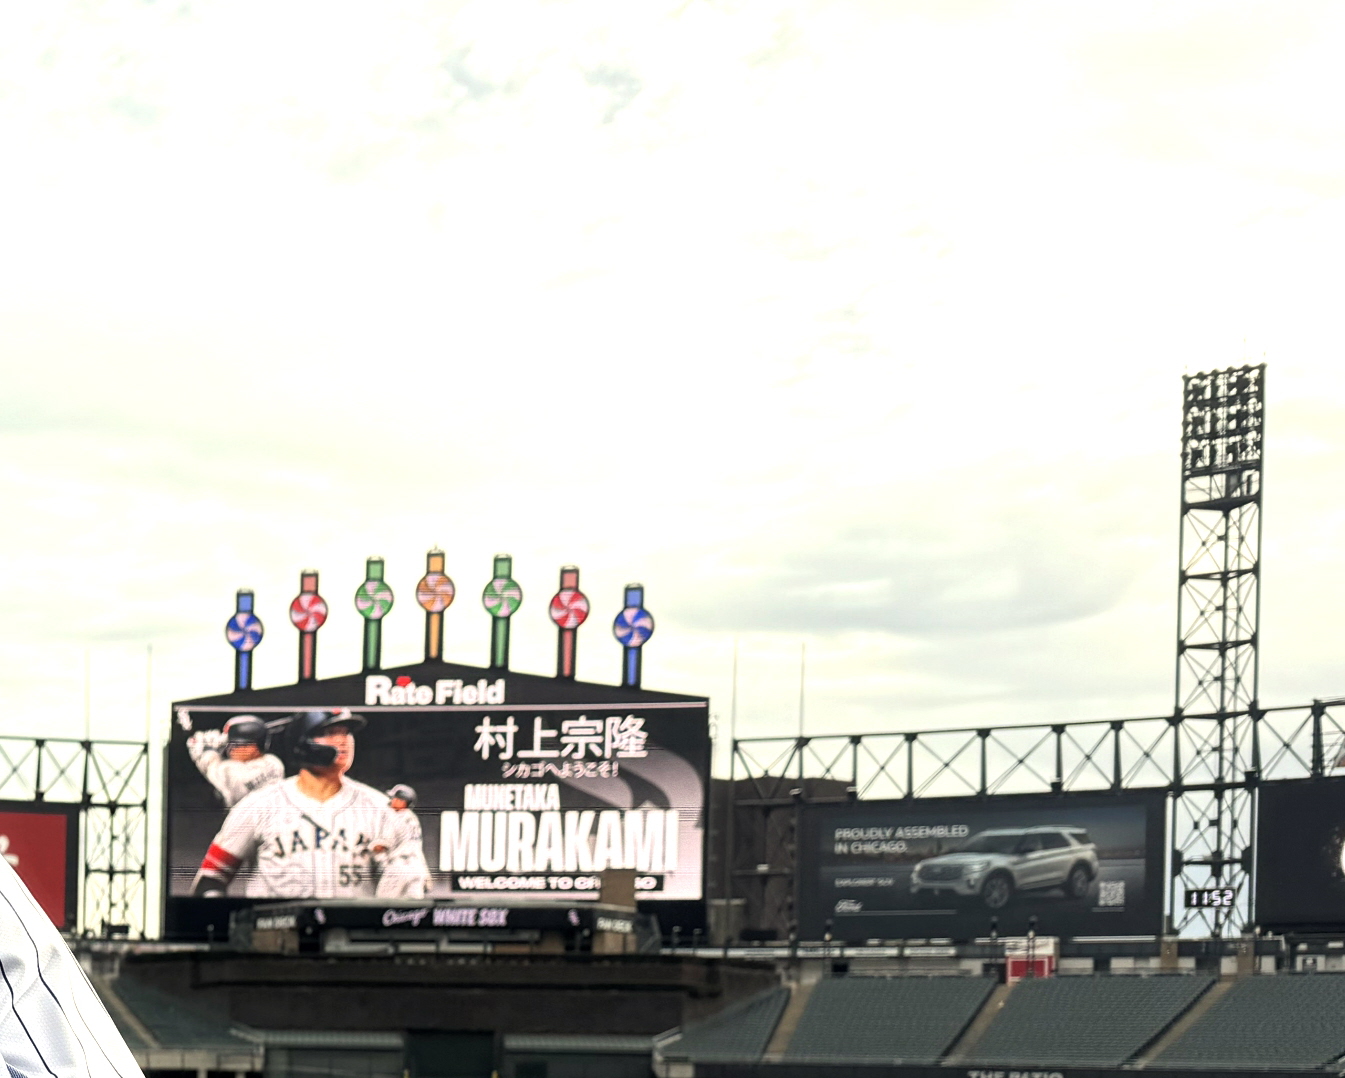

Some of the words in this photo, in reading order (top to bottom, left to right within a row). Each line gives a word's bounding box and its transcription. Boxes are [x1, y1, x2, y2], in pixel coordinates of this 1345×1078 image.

[365, 675, 433, 705] Rate
[435, 679, 505, 705] Field
[474, 714, 649, 760] 村上宗隆
[464, 783, 560, 811] MUNETAKA
[439, 810, 680, 872] MURAKAMI
[835, 827, 894, 840] PROUDLY
[895, 825, 969, 839] ASSEMBLED
[834, 842, 849, 854] IN
[339, 865, 361, 887] 55
[458, 875, 546, 890] WELCOME
[547, 875, 573, 890] TO
[433, 908, 477, 927] WHITE
[478, 908, 508, 927] SOX
